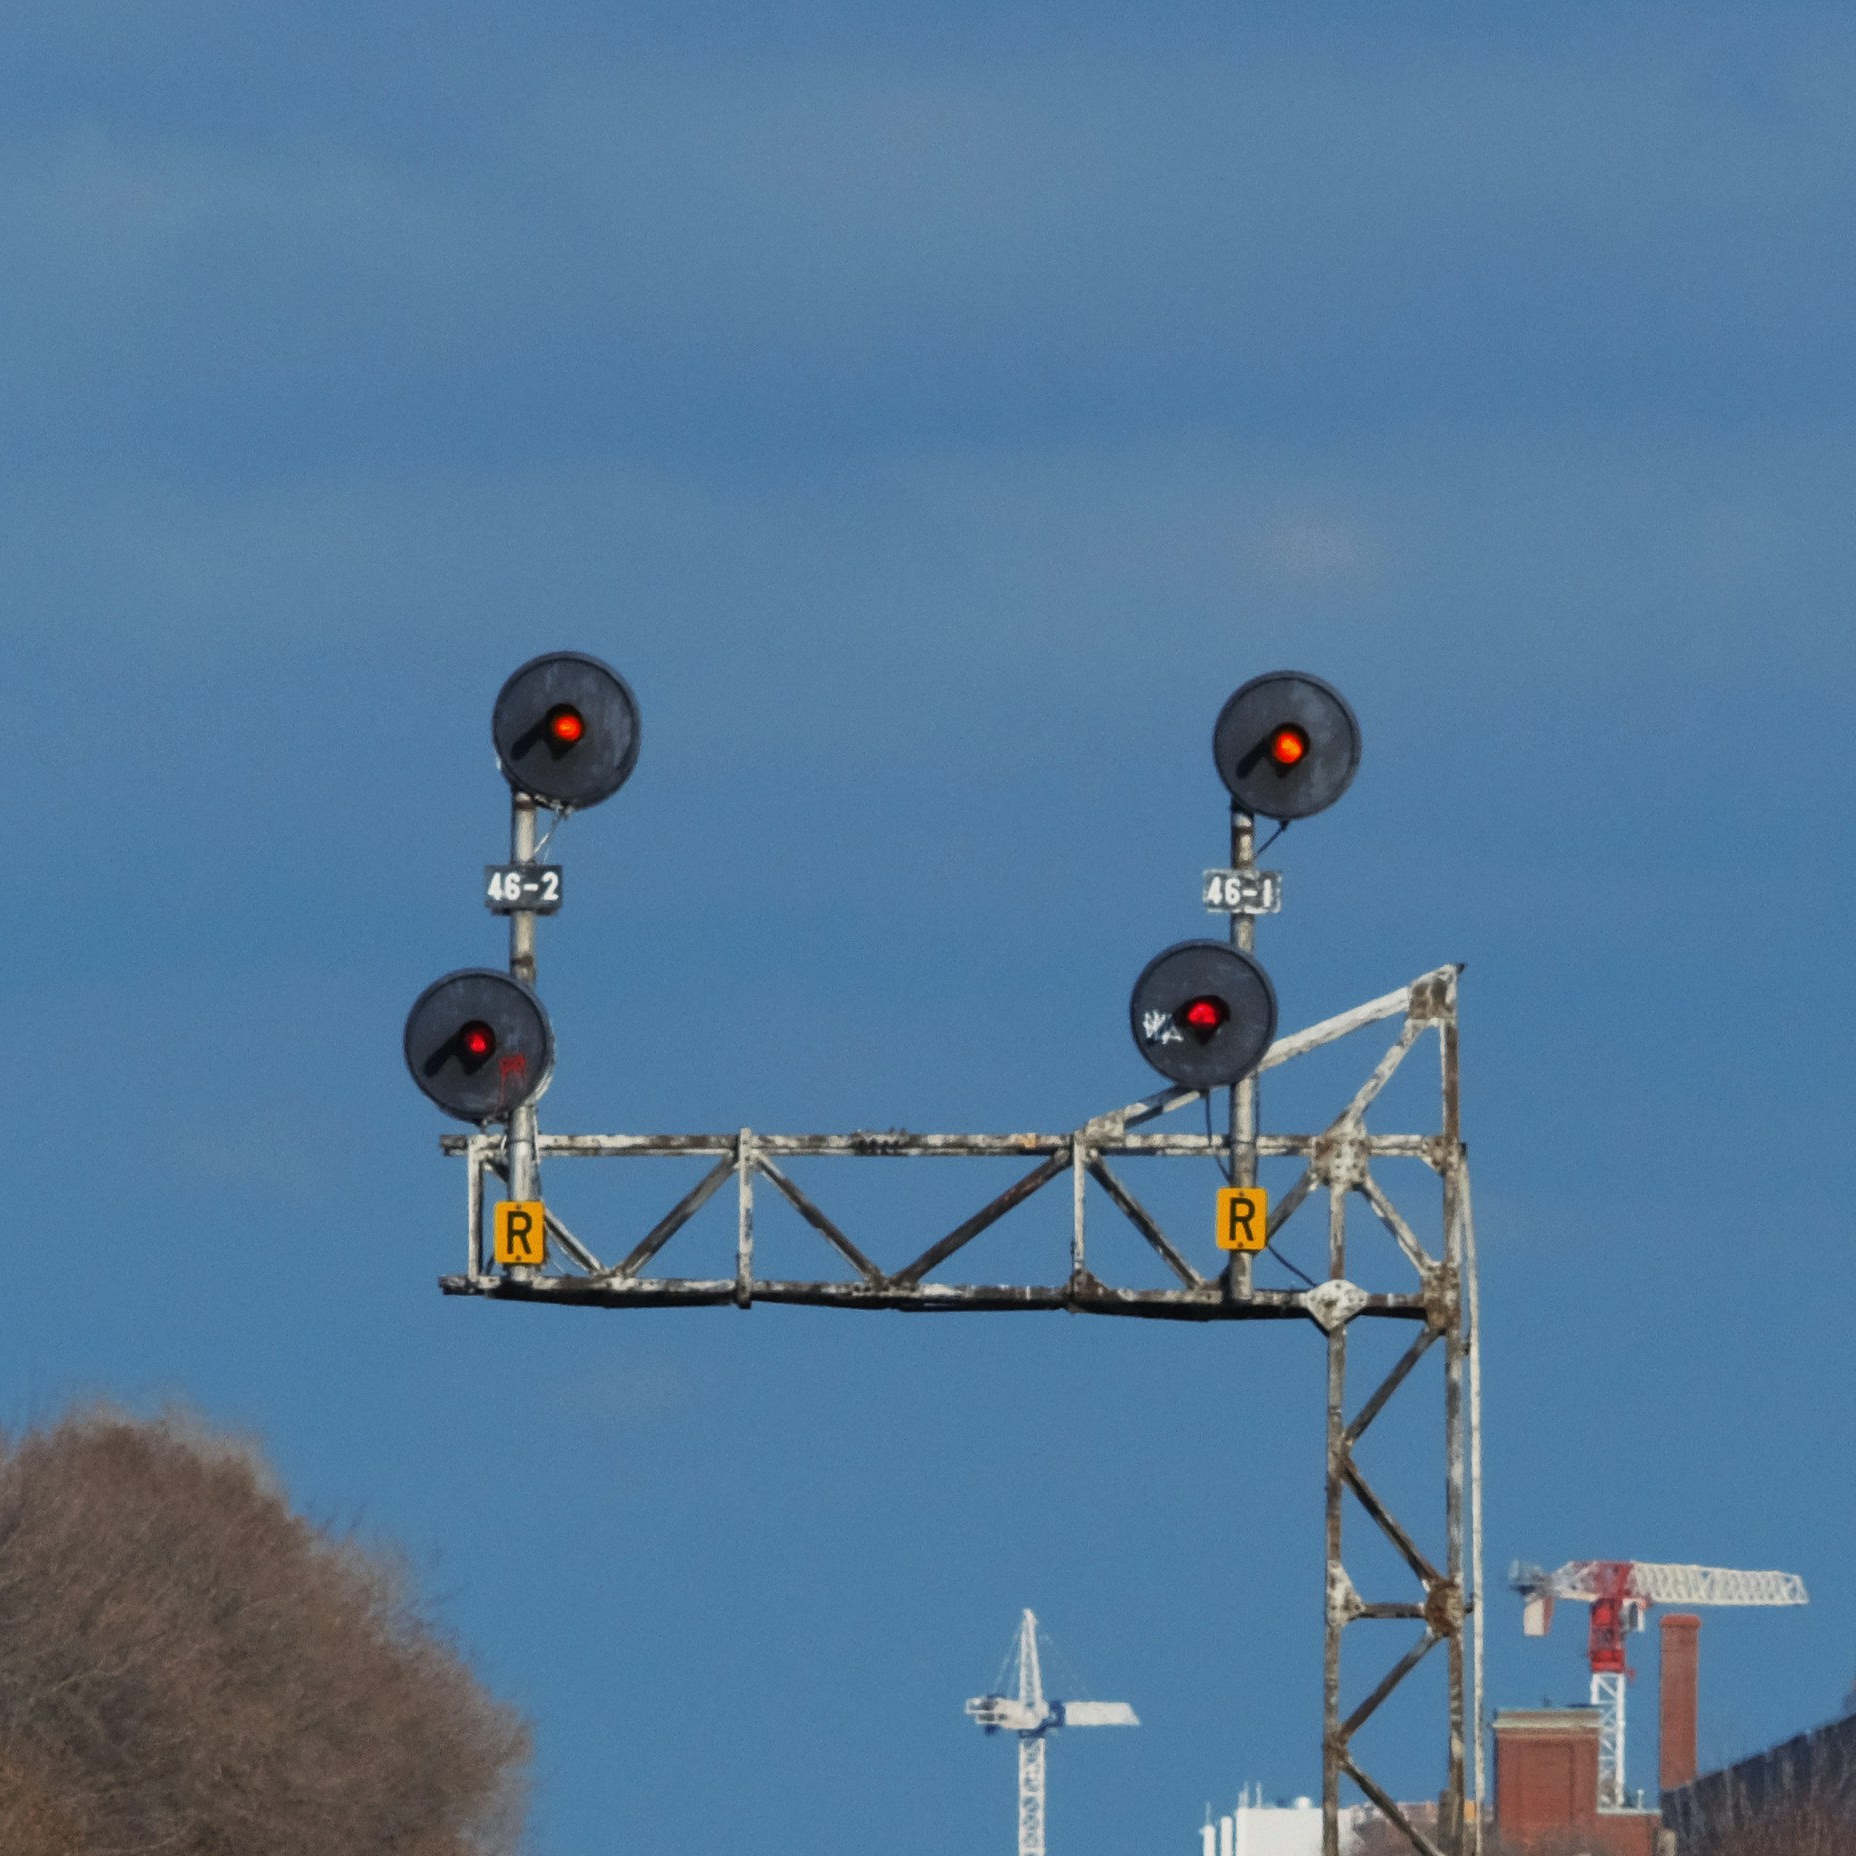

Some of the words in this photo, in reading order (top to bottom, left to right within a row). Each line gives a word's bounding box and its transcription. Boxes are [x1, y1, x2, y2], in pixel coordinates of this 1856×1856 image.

[487, 872, 559, 901] 46-2
[1207, 876, 1272, 907] 46-1
[507, 1210, 532, 1254] R
[1230, 1197, 1255, 1241] R
